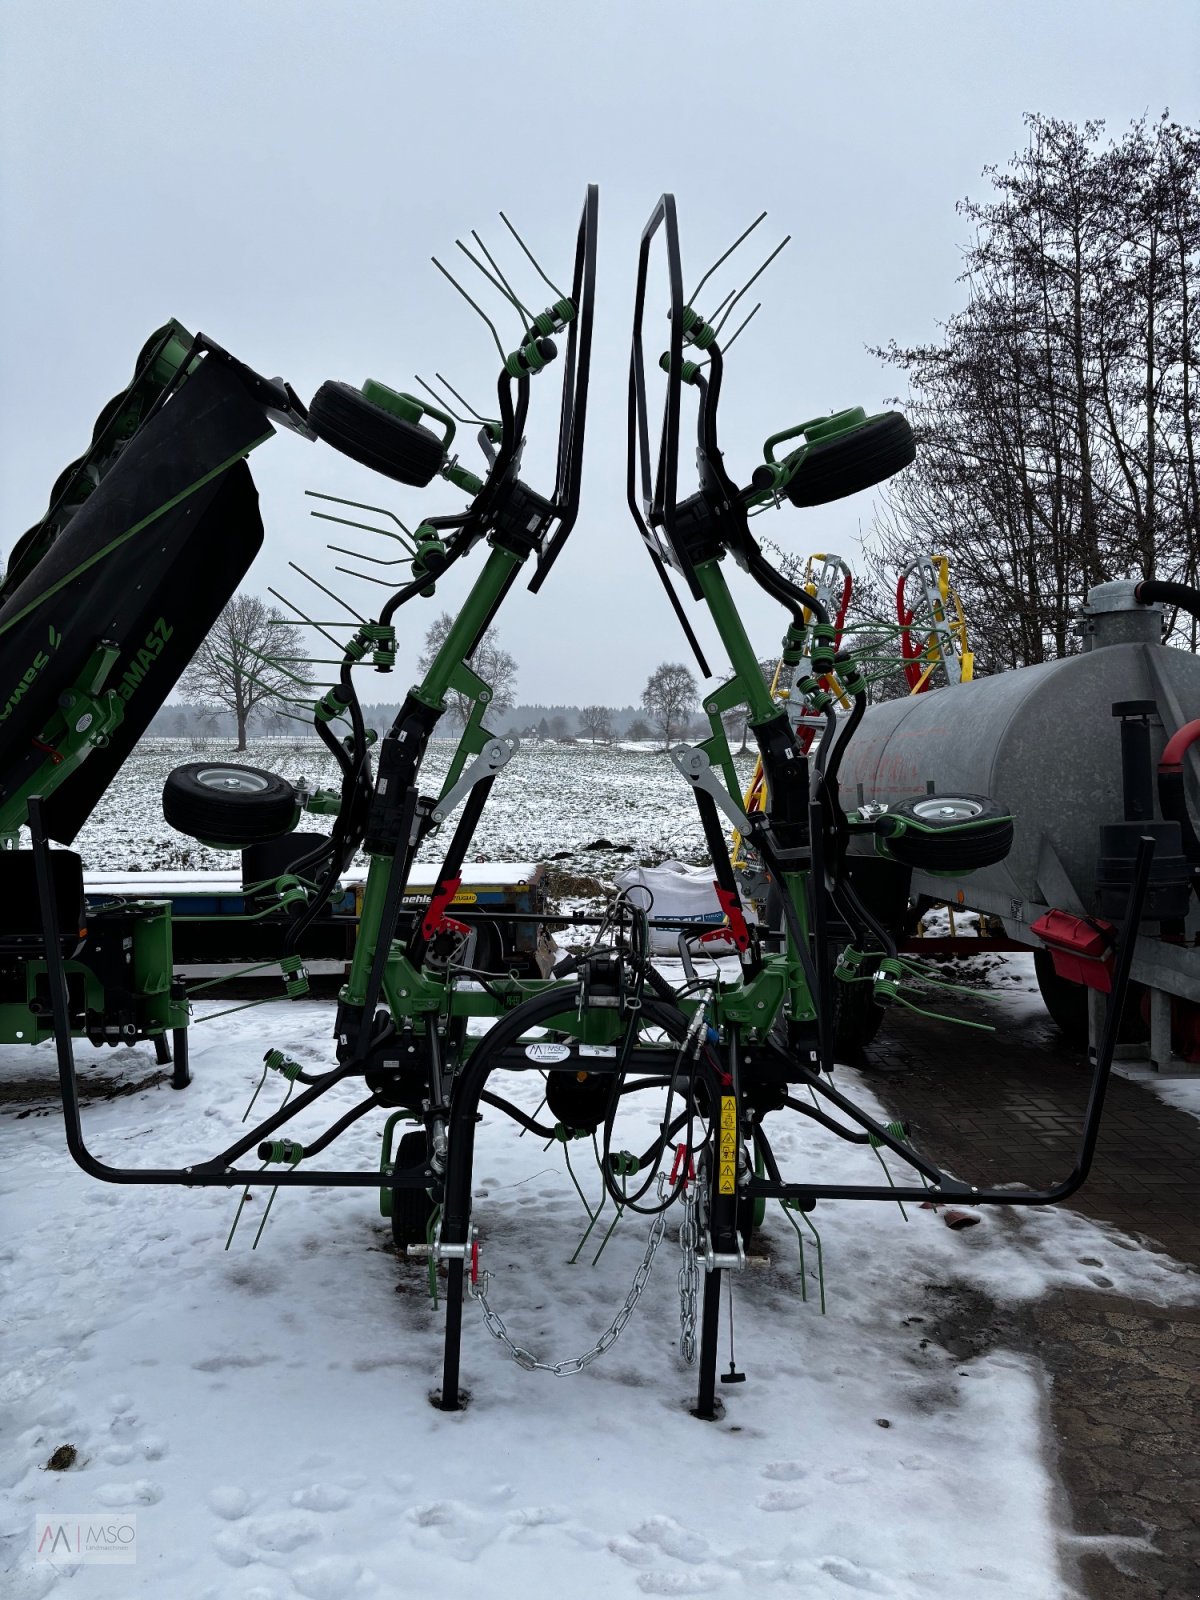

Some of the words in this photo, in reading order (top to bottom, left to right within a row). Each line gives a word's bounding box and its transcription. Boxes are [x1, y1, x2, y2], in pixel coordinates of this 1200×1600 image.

[0, 650, 49, 720] SaMA
[117, 616, 174, 701] aMASZ
[402, 895, 432, 904] oehle
